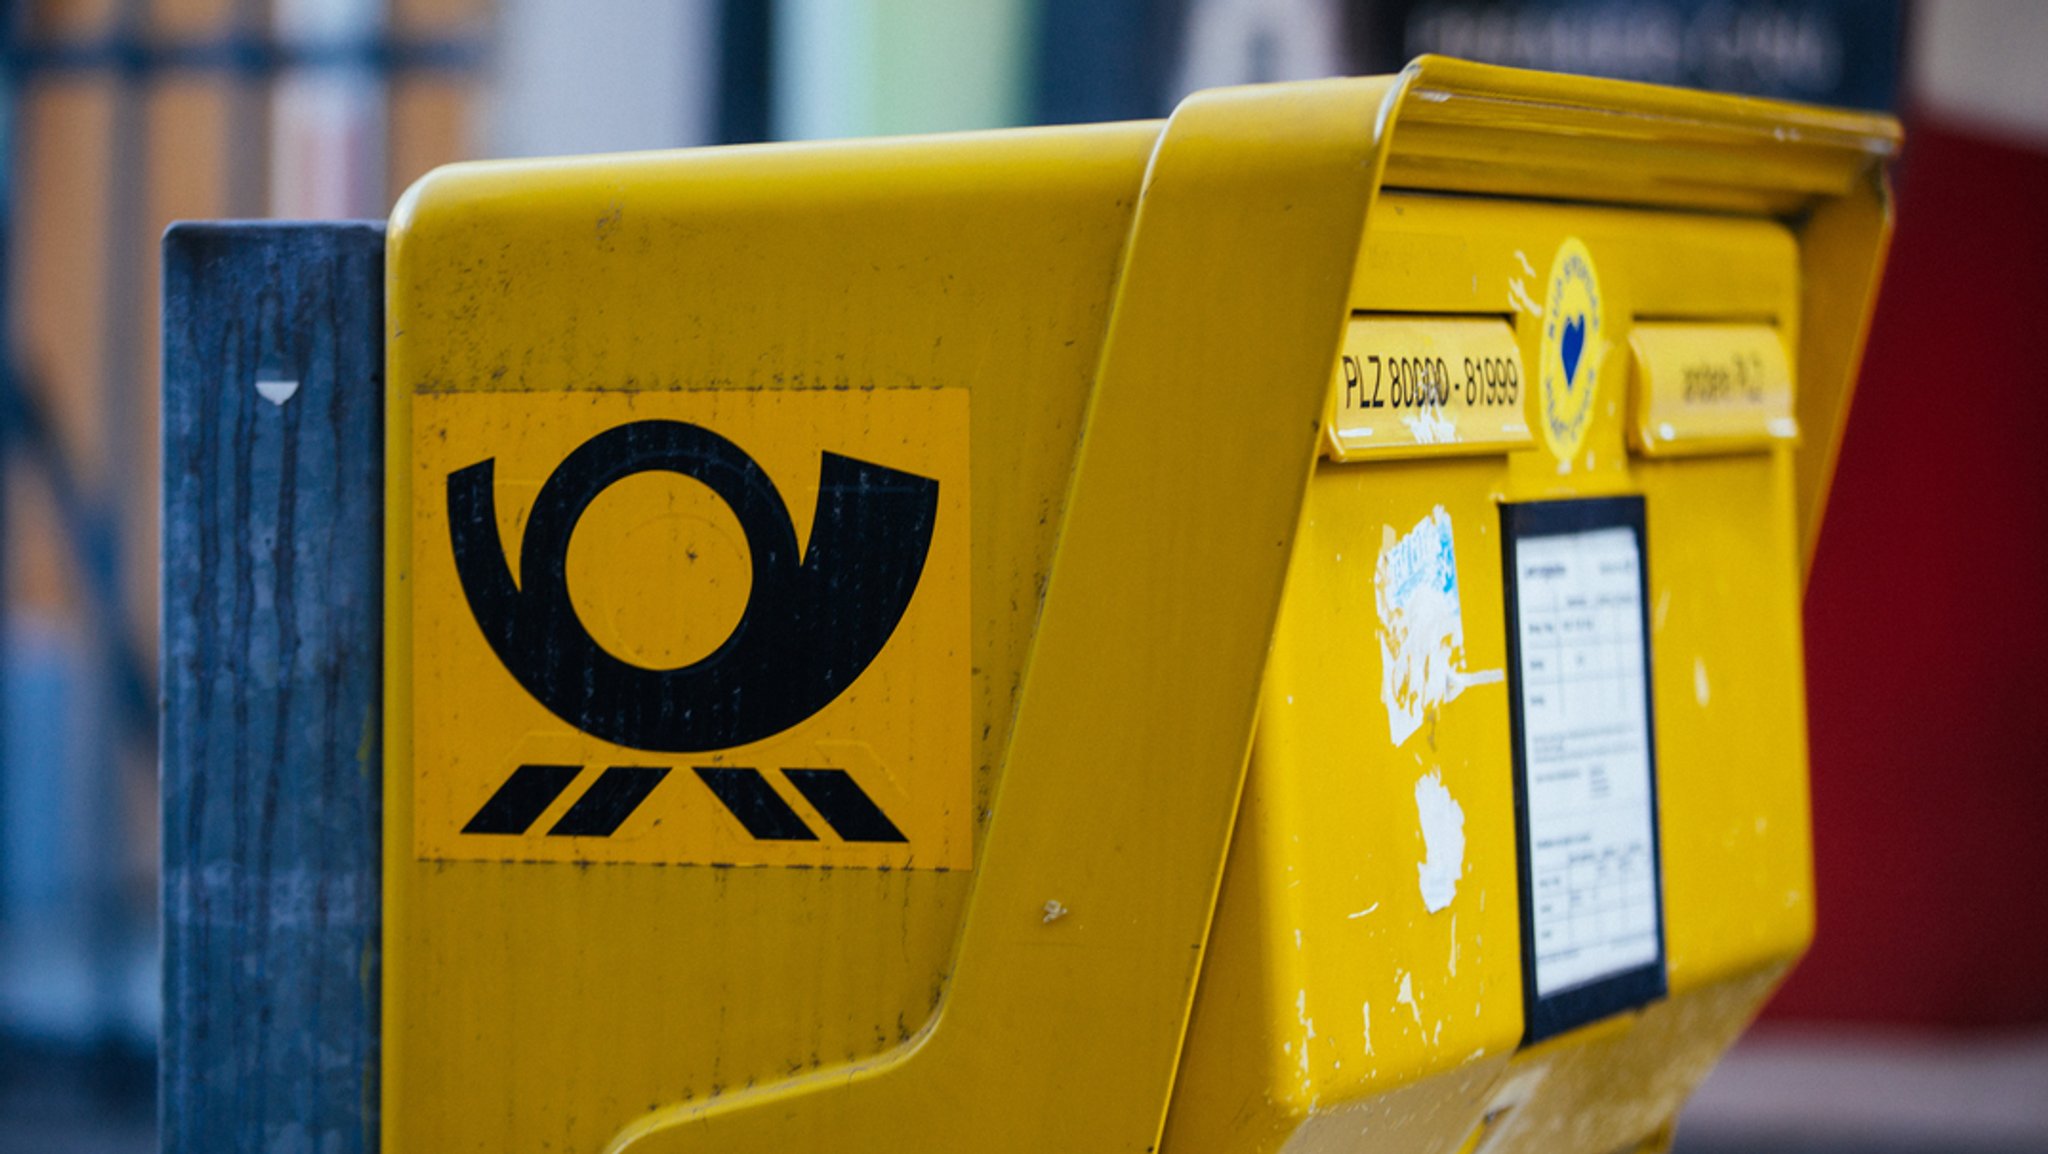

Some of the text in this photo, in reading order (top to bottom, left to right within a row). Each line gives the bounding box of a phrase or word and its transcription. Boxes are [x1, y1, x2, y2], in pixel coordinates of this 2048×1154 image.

[1343, 355, 1384, 408] PLZ
[1388, 356, 1450, 408] 80000
[1464, 357, 1518, 407] 81999
